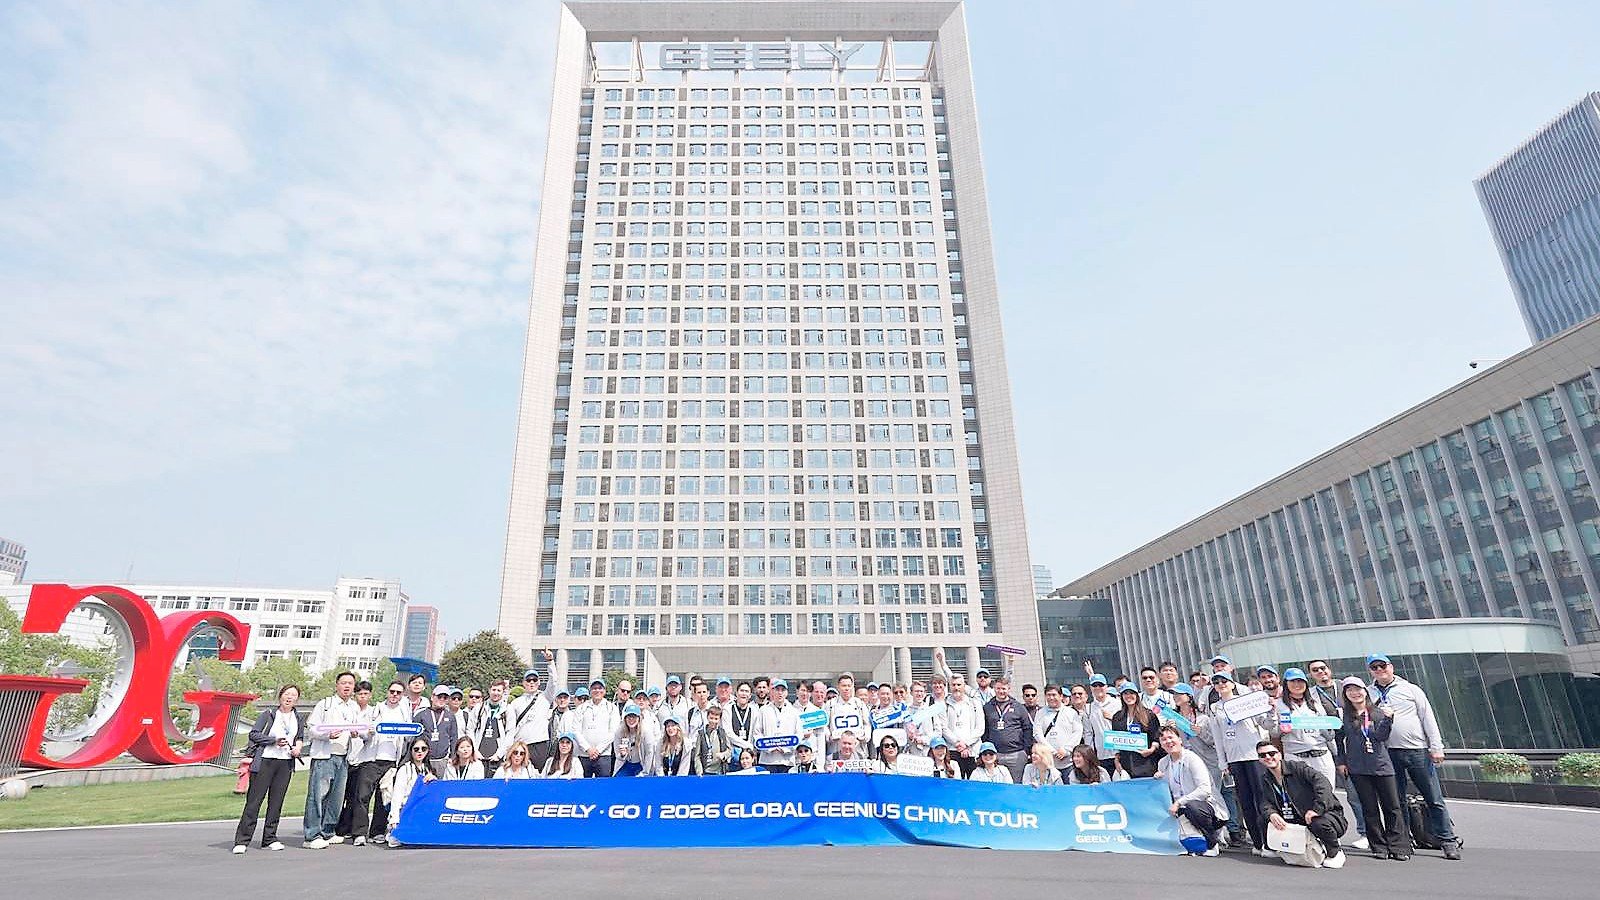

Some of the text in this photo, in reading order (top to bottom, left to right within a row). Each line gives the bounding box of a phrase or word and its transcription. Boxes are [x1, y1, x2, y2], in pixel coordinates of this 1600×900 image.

[660, 43, 864, 69] GEELY
[1112, 737, 1138, 745] GEELY
[845, 760, 875, 768] GEELY
[438, 813, 495, 824] GEELY
[527, 801, 1040, 829] GEELY GO 2026 GLOBAL GEENIUS CHINA TOUR
[1074, 803, 1128, 832] GO
[1075, 834, 1111, 843] GEELY
